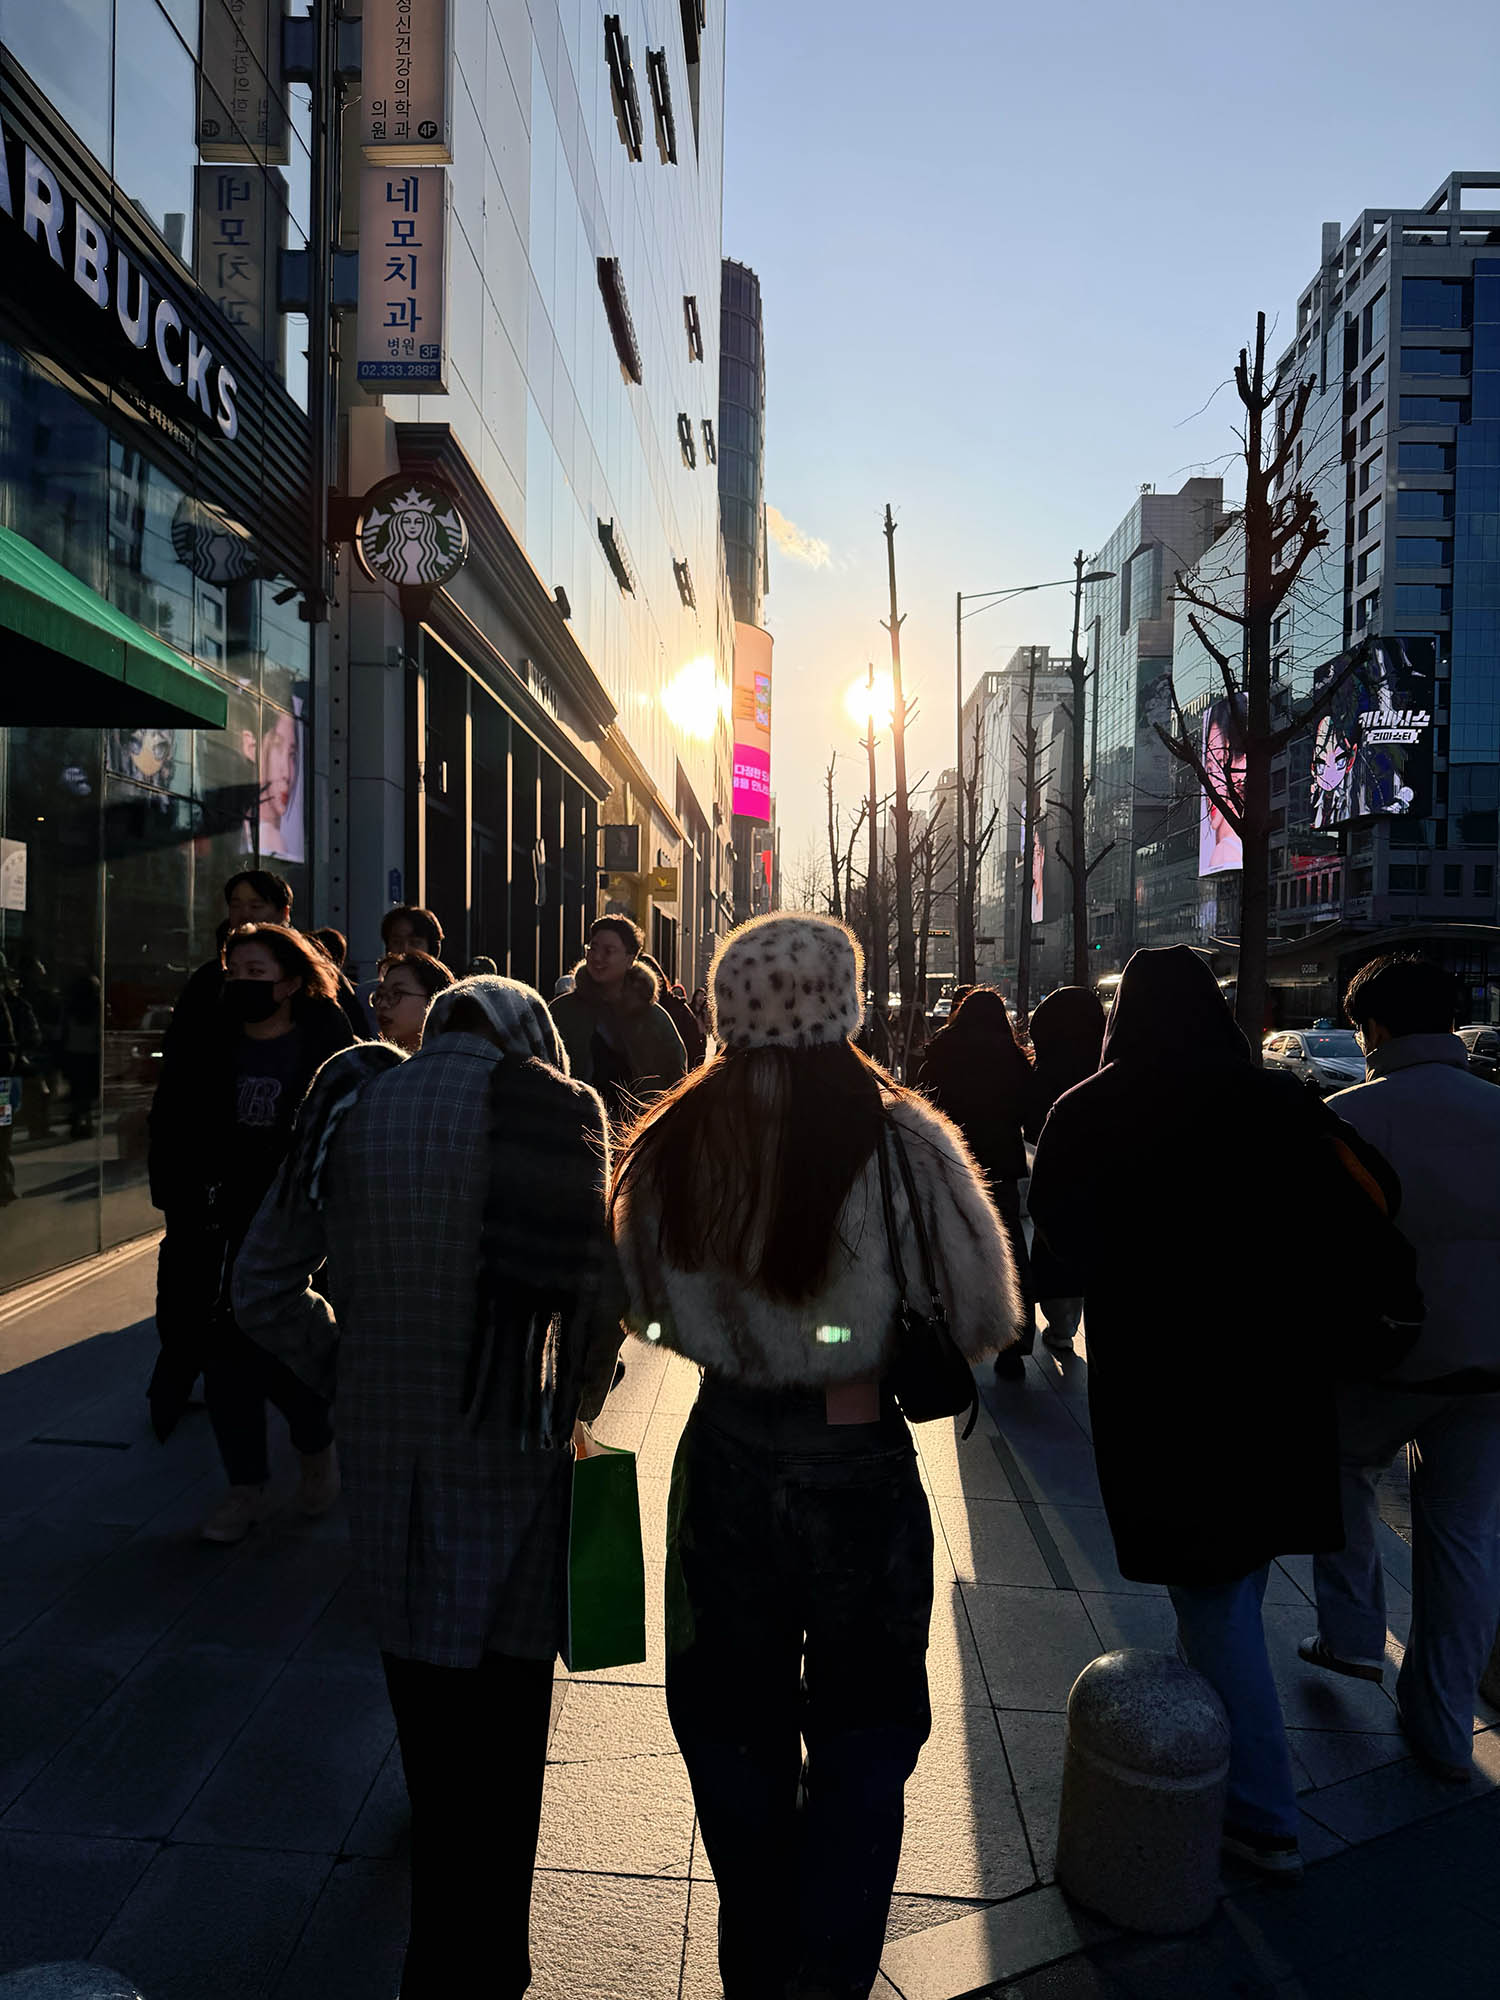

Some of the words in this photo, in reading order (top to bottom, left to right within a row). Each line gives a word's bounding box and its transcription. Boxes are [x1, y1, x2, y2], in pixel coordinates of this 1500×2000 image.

[371, 100, 387, 139] 의원
[419, 122, 436, 137] 4F
[383, 176, 422, 332] 네모치과
[388, 337, 415, 357] 병원
[421, 345, 439, 358] 3F
[361, 364, 437, 377] 02.333.2882
